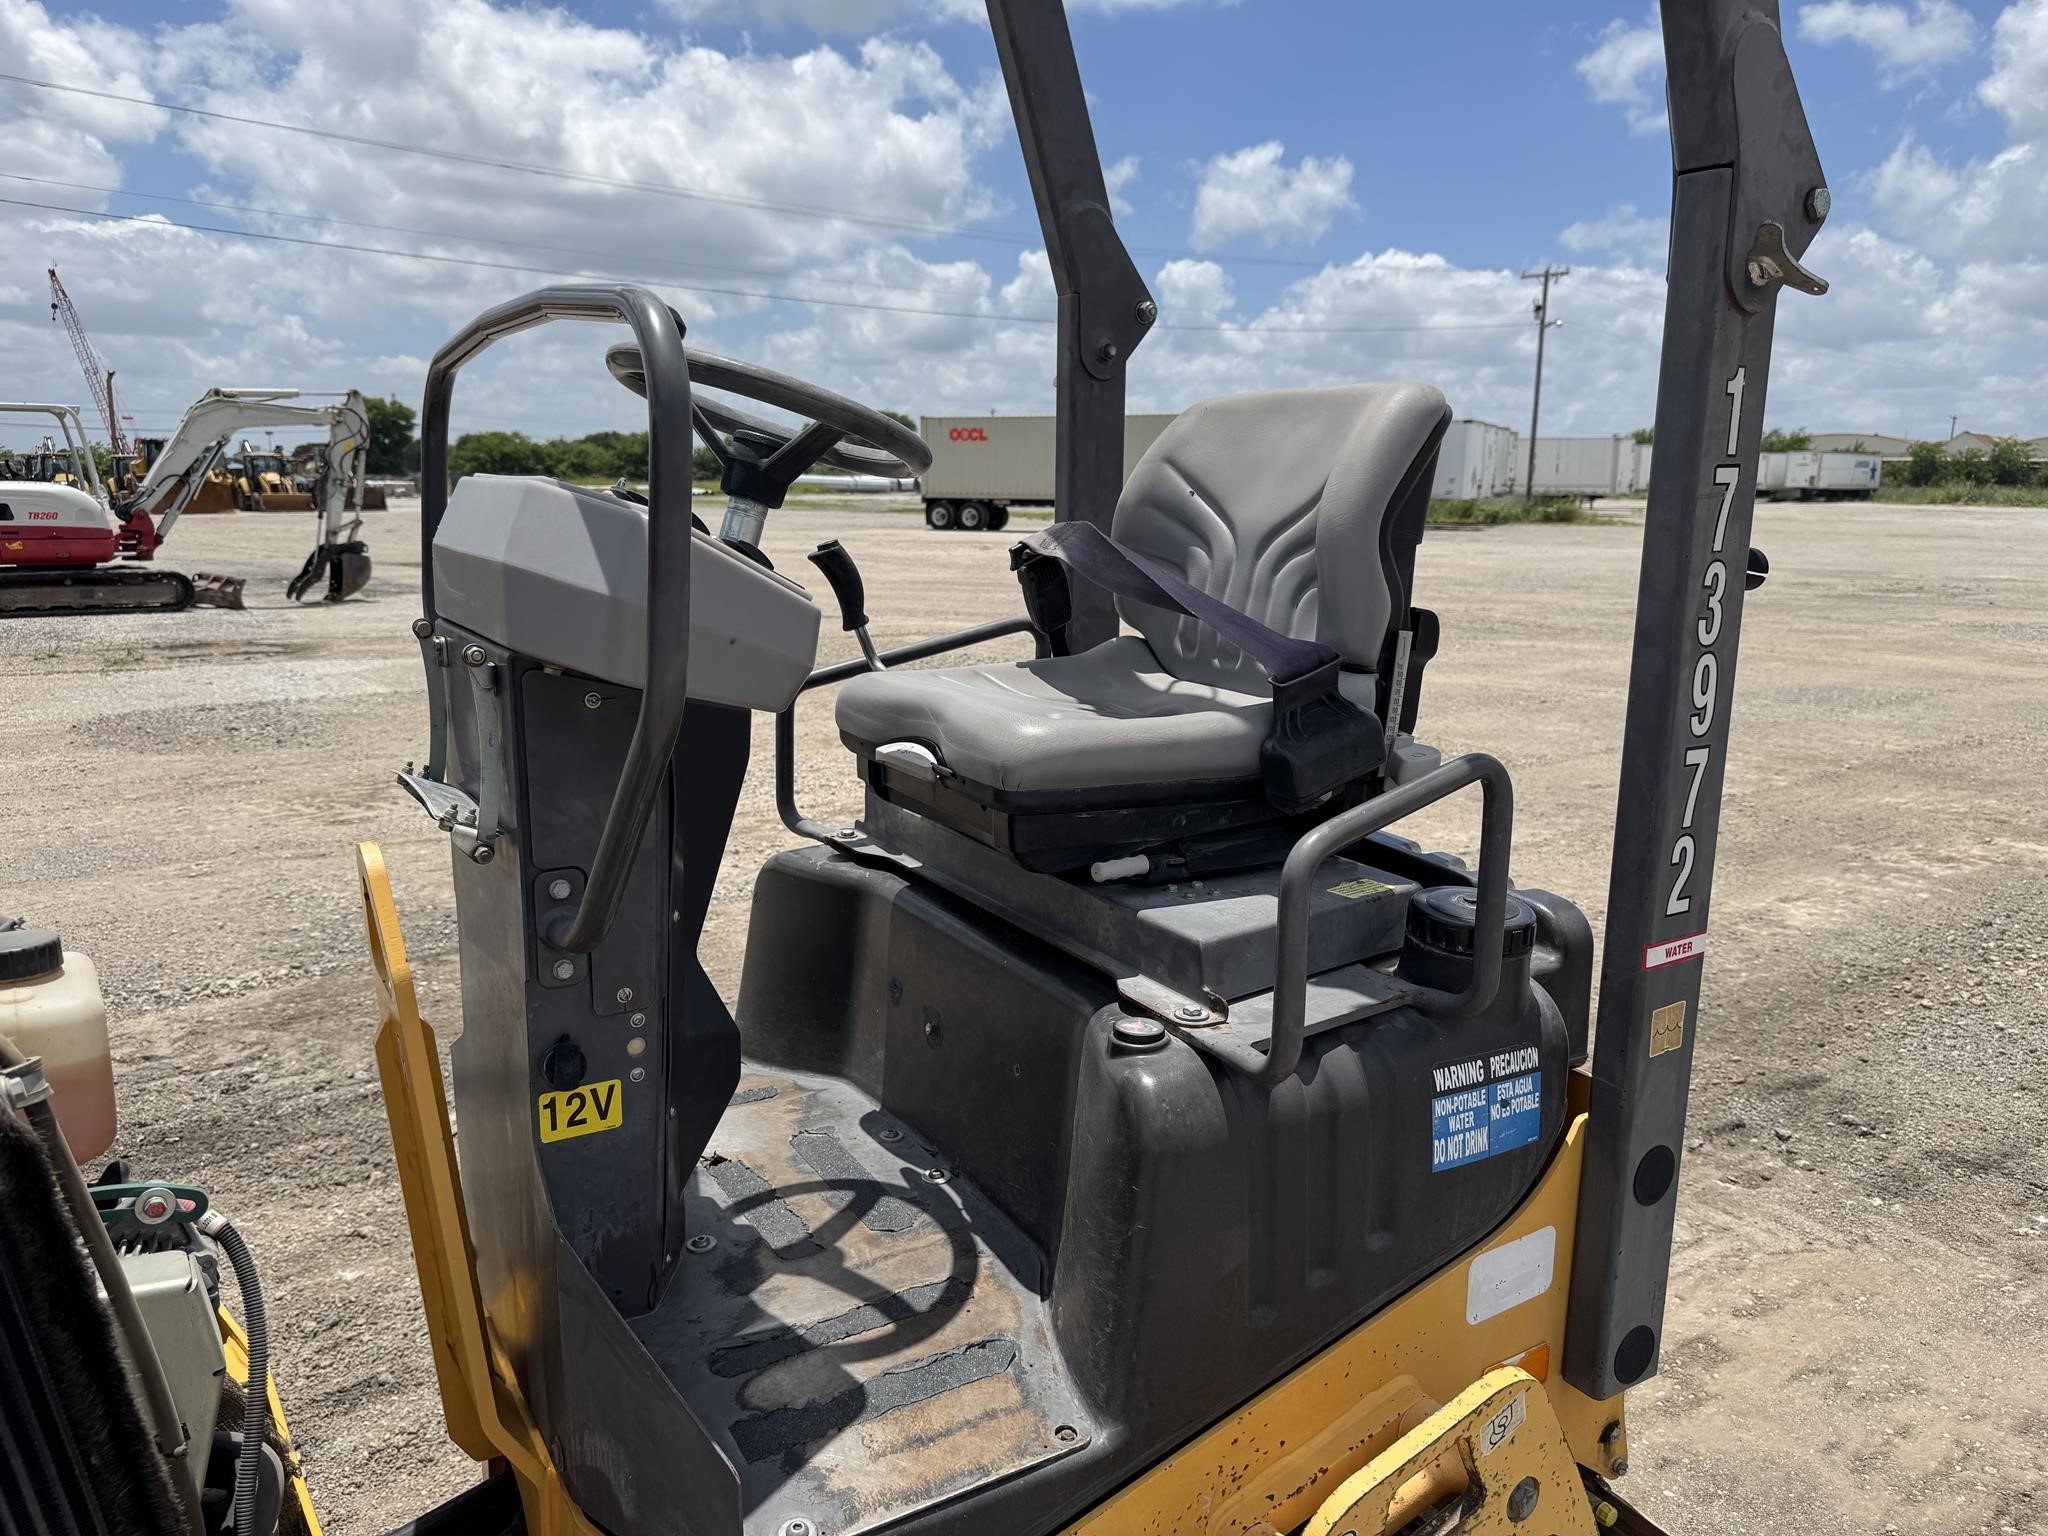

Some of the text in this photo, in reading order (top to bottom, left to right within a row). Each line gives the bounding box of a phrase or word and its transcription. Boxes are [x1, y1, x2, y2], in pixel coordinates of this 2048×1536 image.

[949, 428, 988, 442] OOCL
[28, 511, 59, 520] TB260
[1665, 366, 1746, 918] 1773972
[1665, 941, 1693, 959] WATER
[1433, 1059, 1485, 1092] WARNING
[1490, 1047, 1539, 1079] PRECAUCION
[1497, 1076, 1533, 1101] ESTA AGUA
[542, 1084, 616, 1132] 12V
[1435, 1089, 1486, 1118] NON-POTABLE
[1490, 1103, 1500, 1121] NO
[1511, 1092, 1540, 1115] POTABLE
[1448, 1111, 1475, 1133] WATER
[1434, 1126, 1489, 1165] DO NOT DRINK
